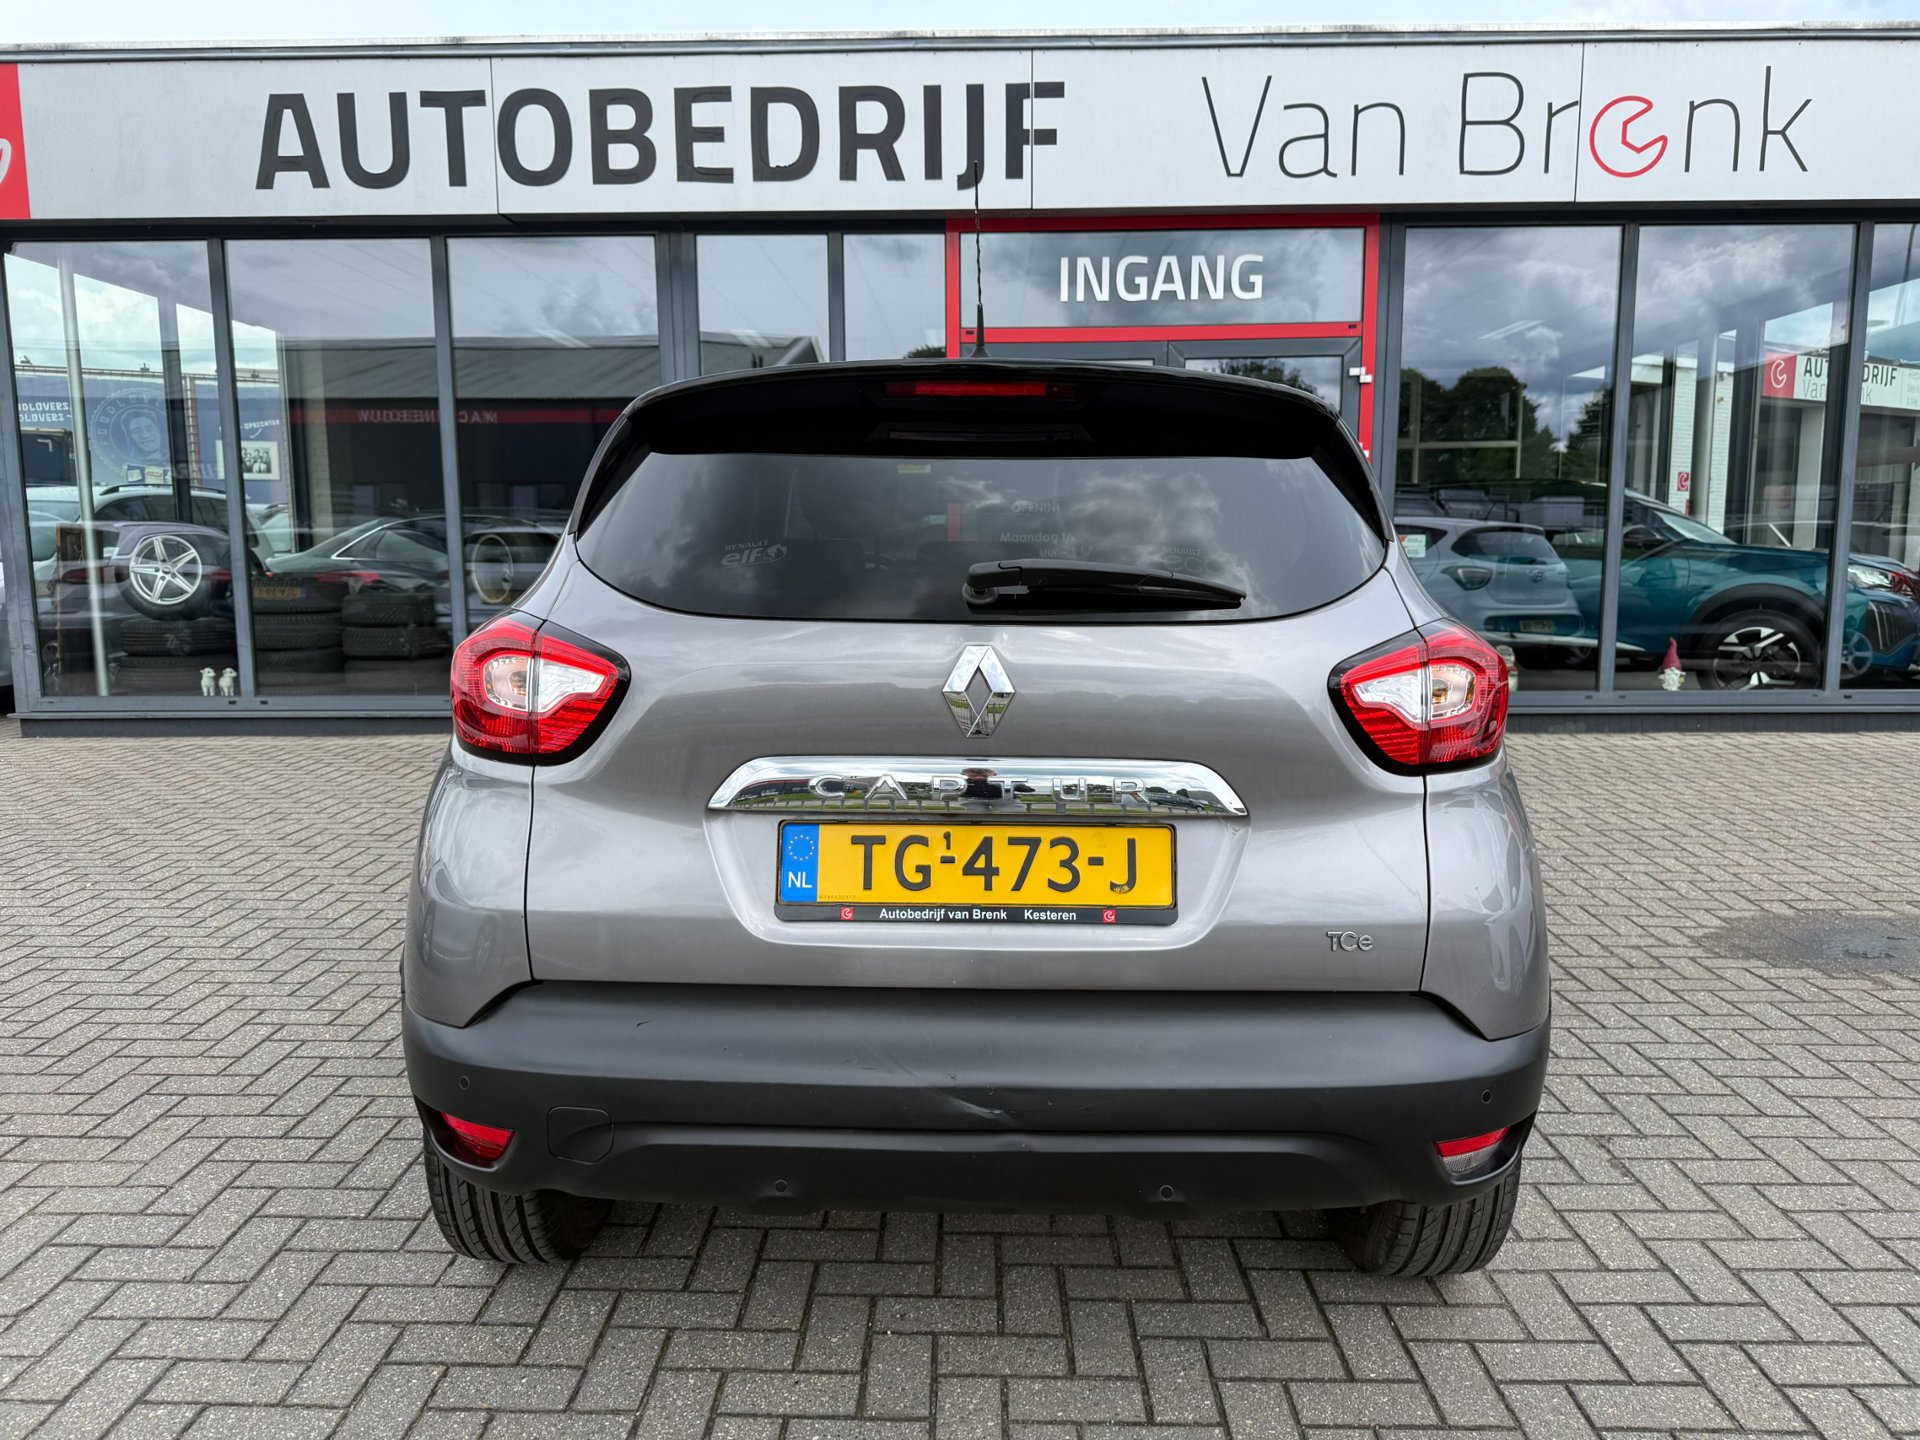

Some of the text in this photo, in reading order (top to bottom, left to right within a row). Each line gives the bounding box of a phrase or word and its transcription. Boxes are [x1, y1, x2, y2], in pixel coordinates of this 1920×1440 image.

[256, 82, 1065, 190] AUTOBEDRIJF
[1201, 75, 1405, 178] Van
[1060, 254, 1263, 302] INGANG
[1000, 532, 1058, 544] Maandag
[721, 548, 762, 566] elf
[809, 775, 1149, 804] CAPTUR
[788, 834, 1137, 893] NL TG-473-J
[879, 909, 1077, 921] Autobedrijf van Brenk Kesteren
[1326, 931, 1373, 951] TCe
